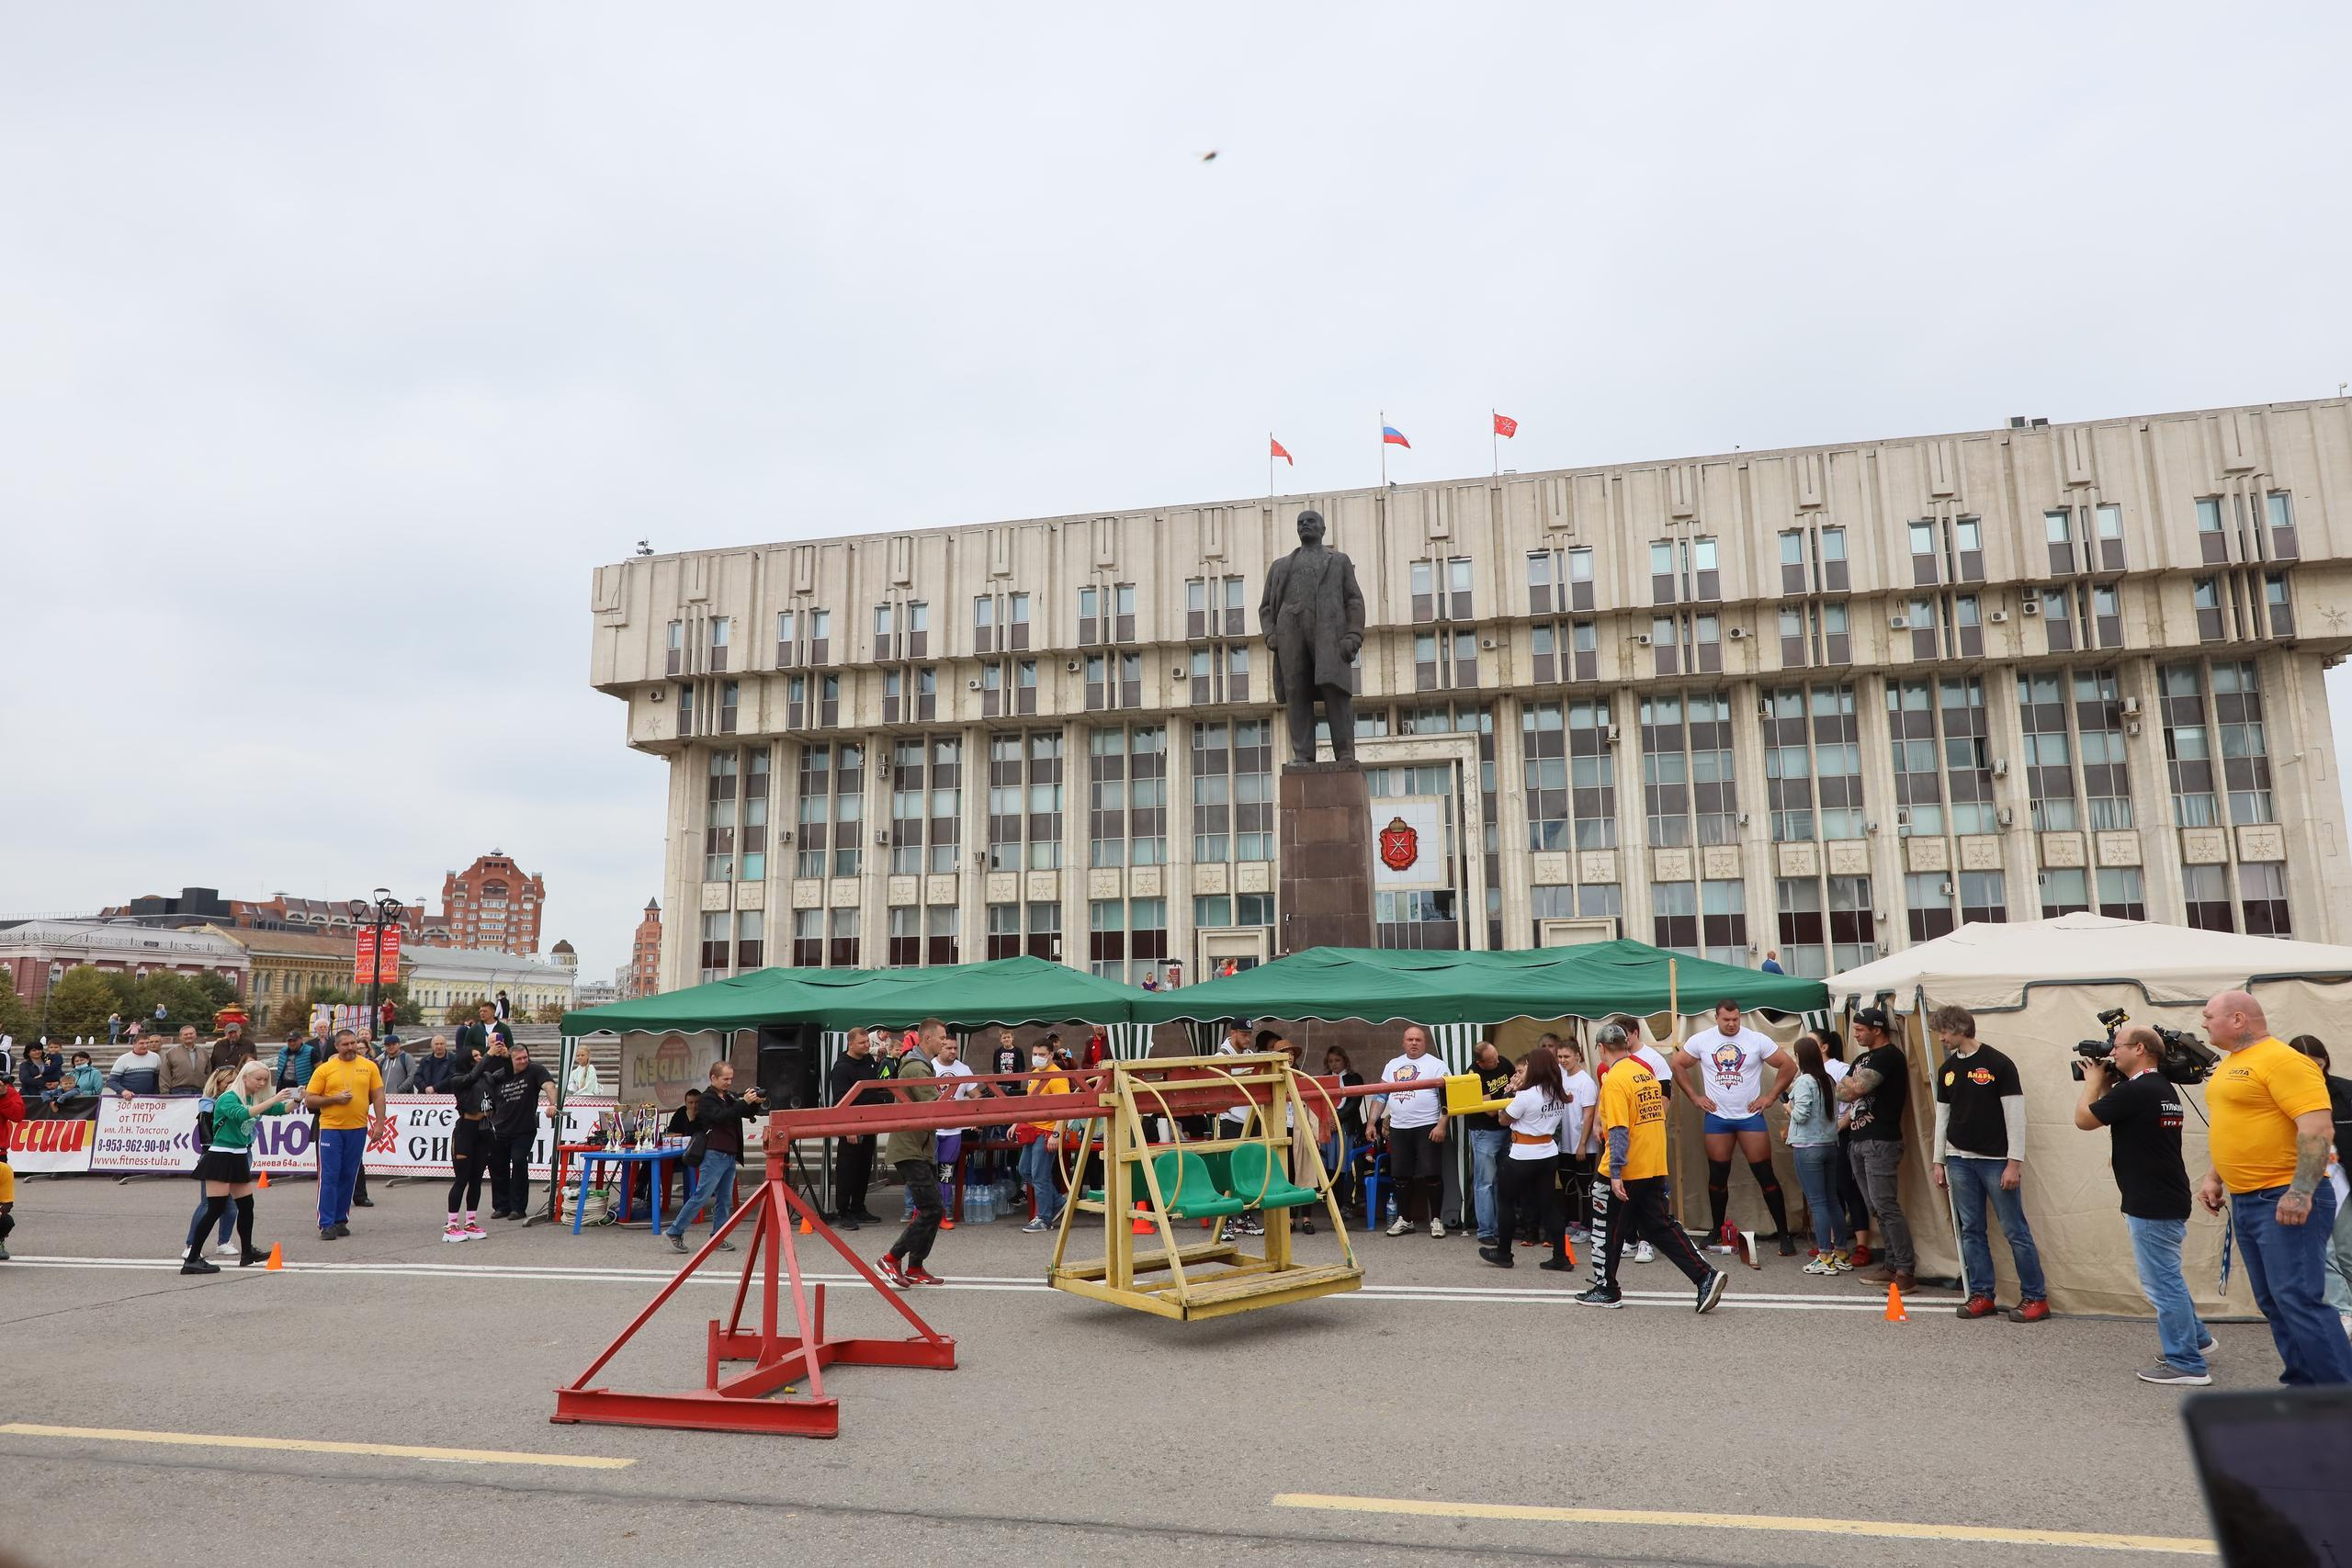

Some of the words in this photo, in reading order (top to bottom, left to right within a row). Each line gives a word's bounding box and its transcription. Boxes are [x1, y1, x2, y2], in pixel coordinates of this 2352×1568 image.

[117, 1102, 132, 1111] 300
[133, 1102, 166, 1112] метров
[119, 1115, 130, 1123] от
[131, 1113, 155, 1122] ТГПУ
[136, 1126, 169, 1134] Толстого
[97, 1138, 171, 1153] 8-953-962-90-04
[94, 1155, 180, 1167] www.fitness-tula.ru
